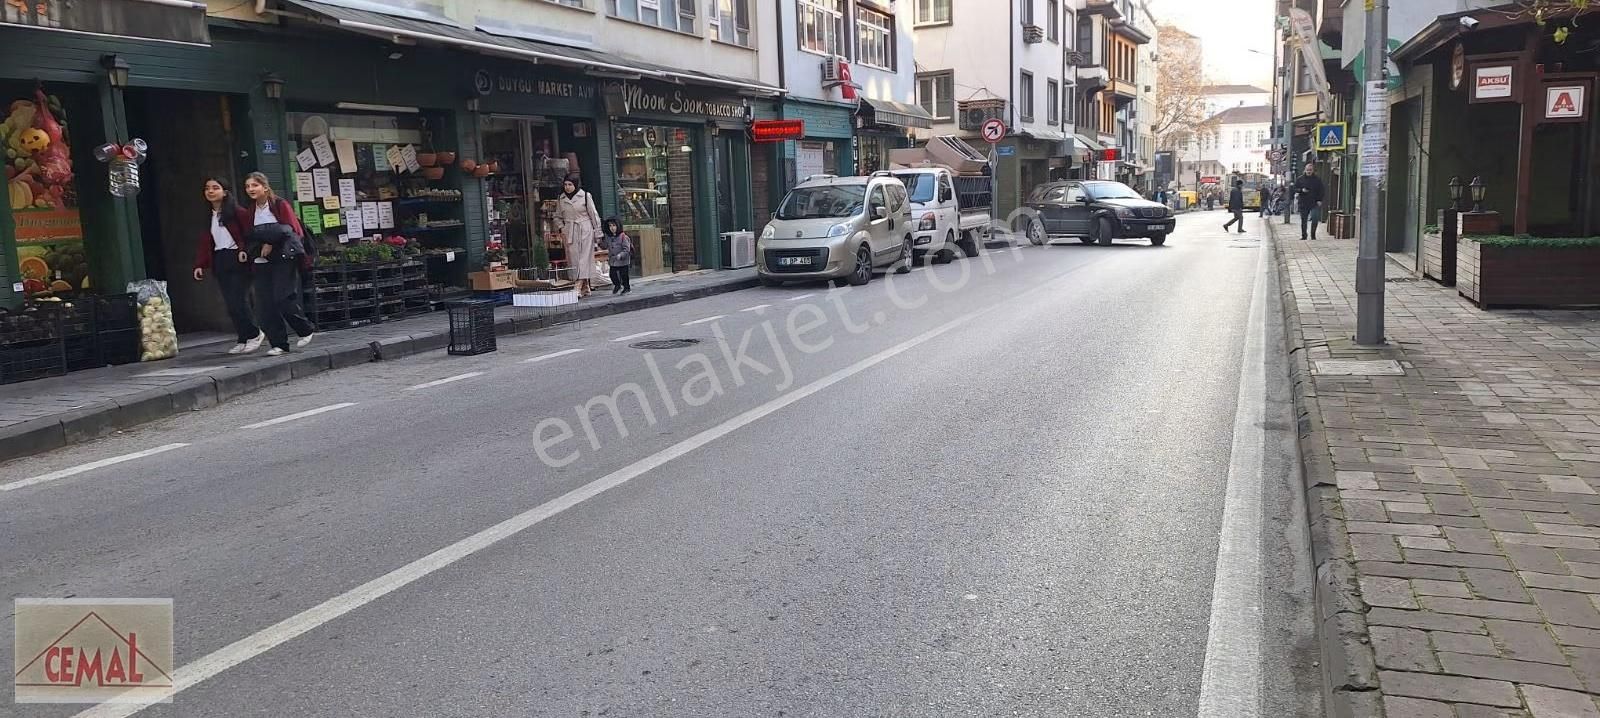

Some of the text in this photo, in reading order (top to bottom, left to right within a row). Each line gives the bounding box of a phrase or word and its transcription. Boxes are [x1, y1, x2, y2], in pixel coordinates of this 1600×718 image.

[499, 77, 531, 93] DUYGU
[538, 81, 573, 97] MARKET
[1481, 76, 1507, 85] AKSU
[621, 84, 745, 118] Moon Soon TOBACCO SHOP
